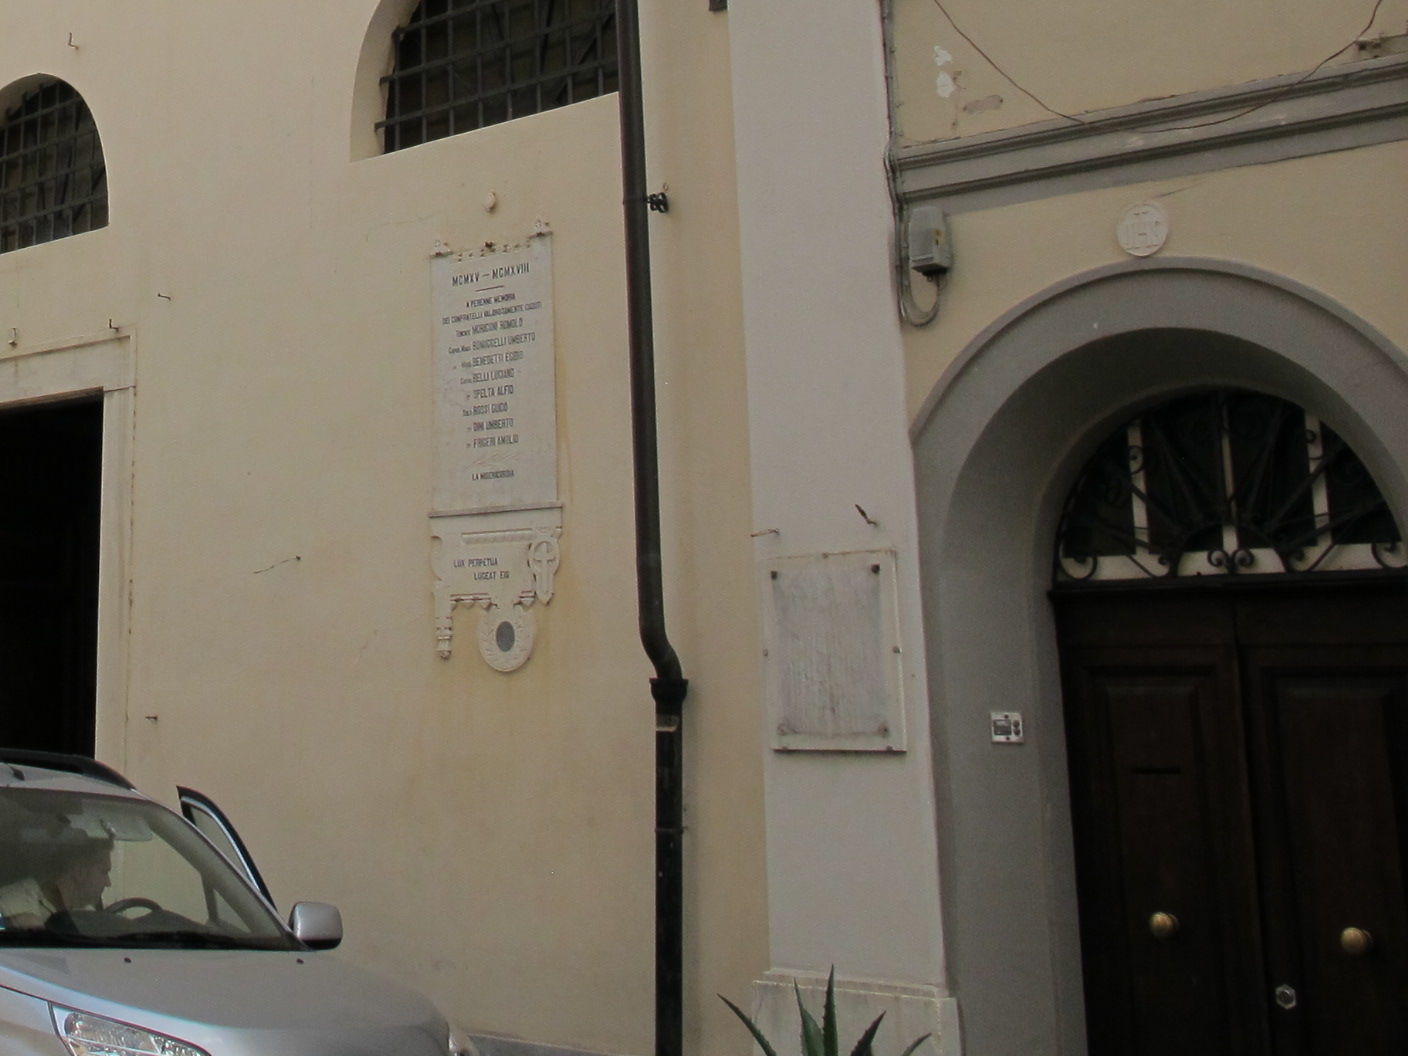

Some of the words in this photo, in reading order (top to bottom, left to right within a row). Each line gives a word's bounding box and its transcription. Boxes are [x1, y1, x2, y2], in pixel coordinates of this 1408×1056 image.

[452, 272, 480, 286] MCMXV
[492, 263, 529, 279] MCMXVIII
[468, 557, 498, 568] PERPETUA
